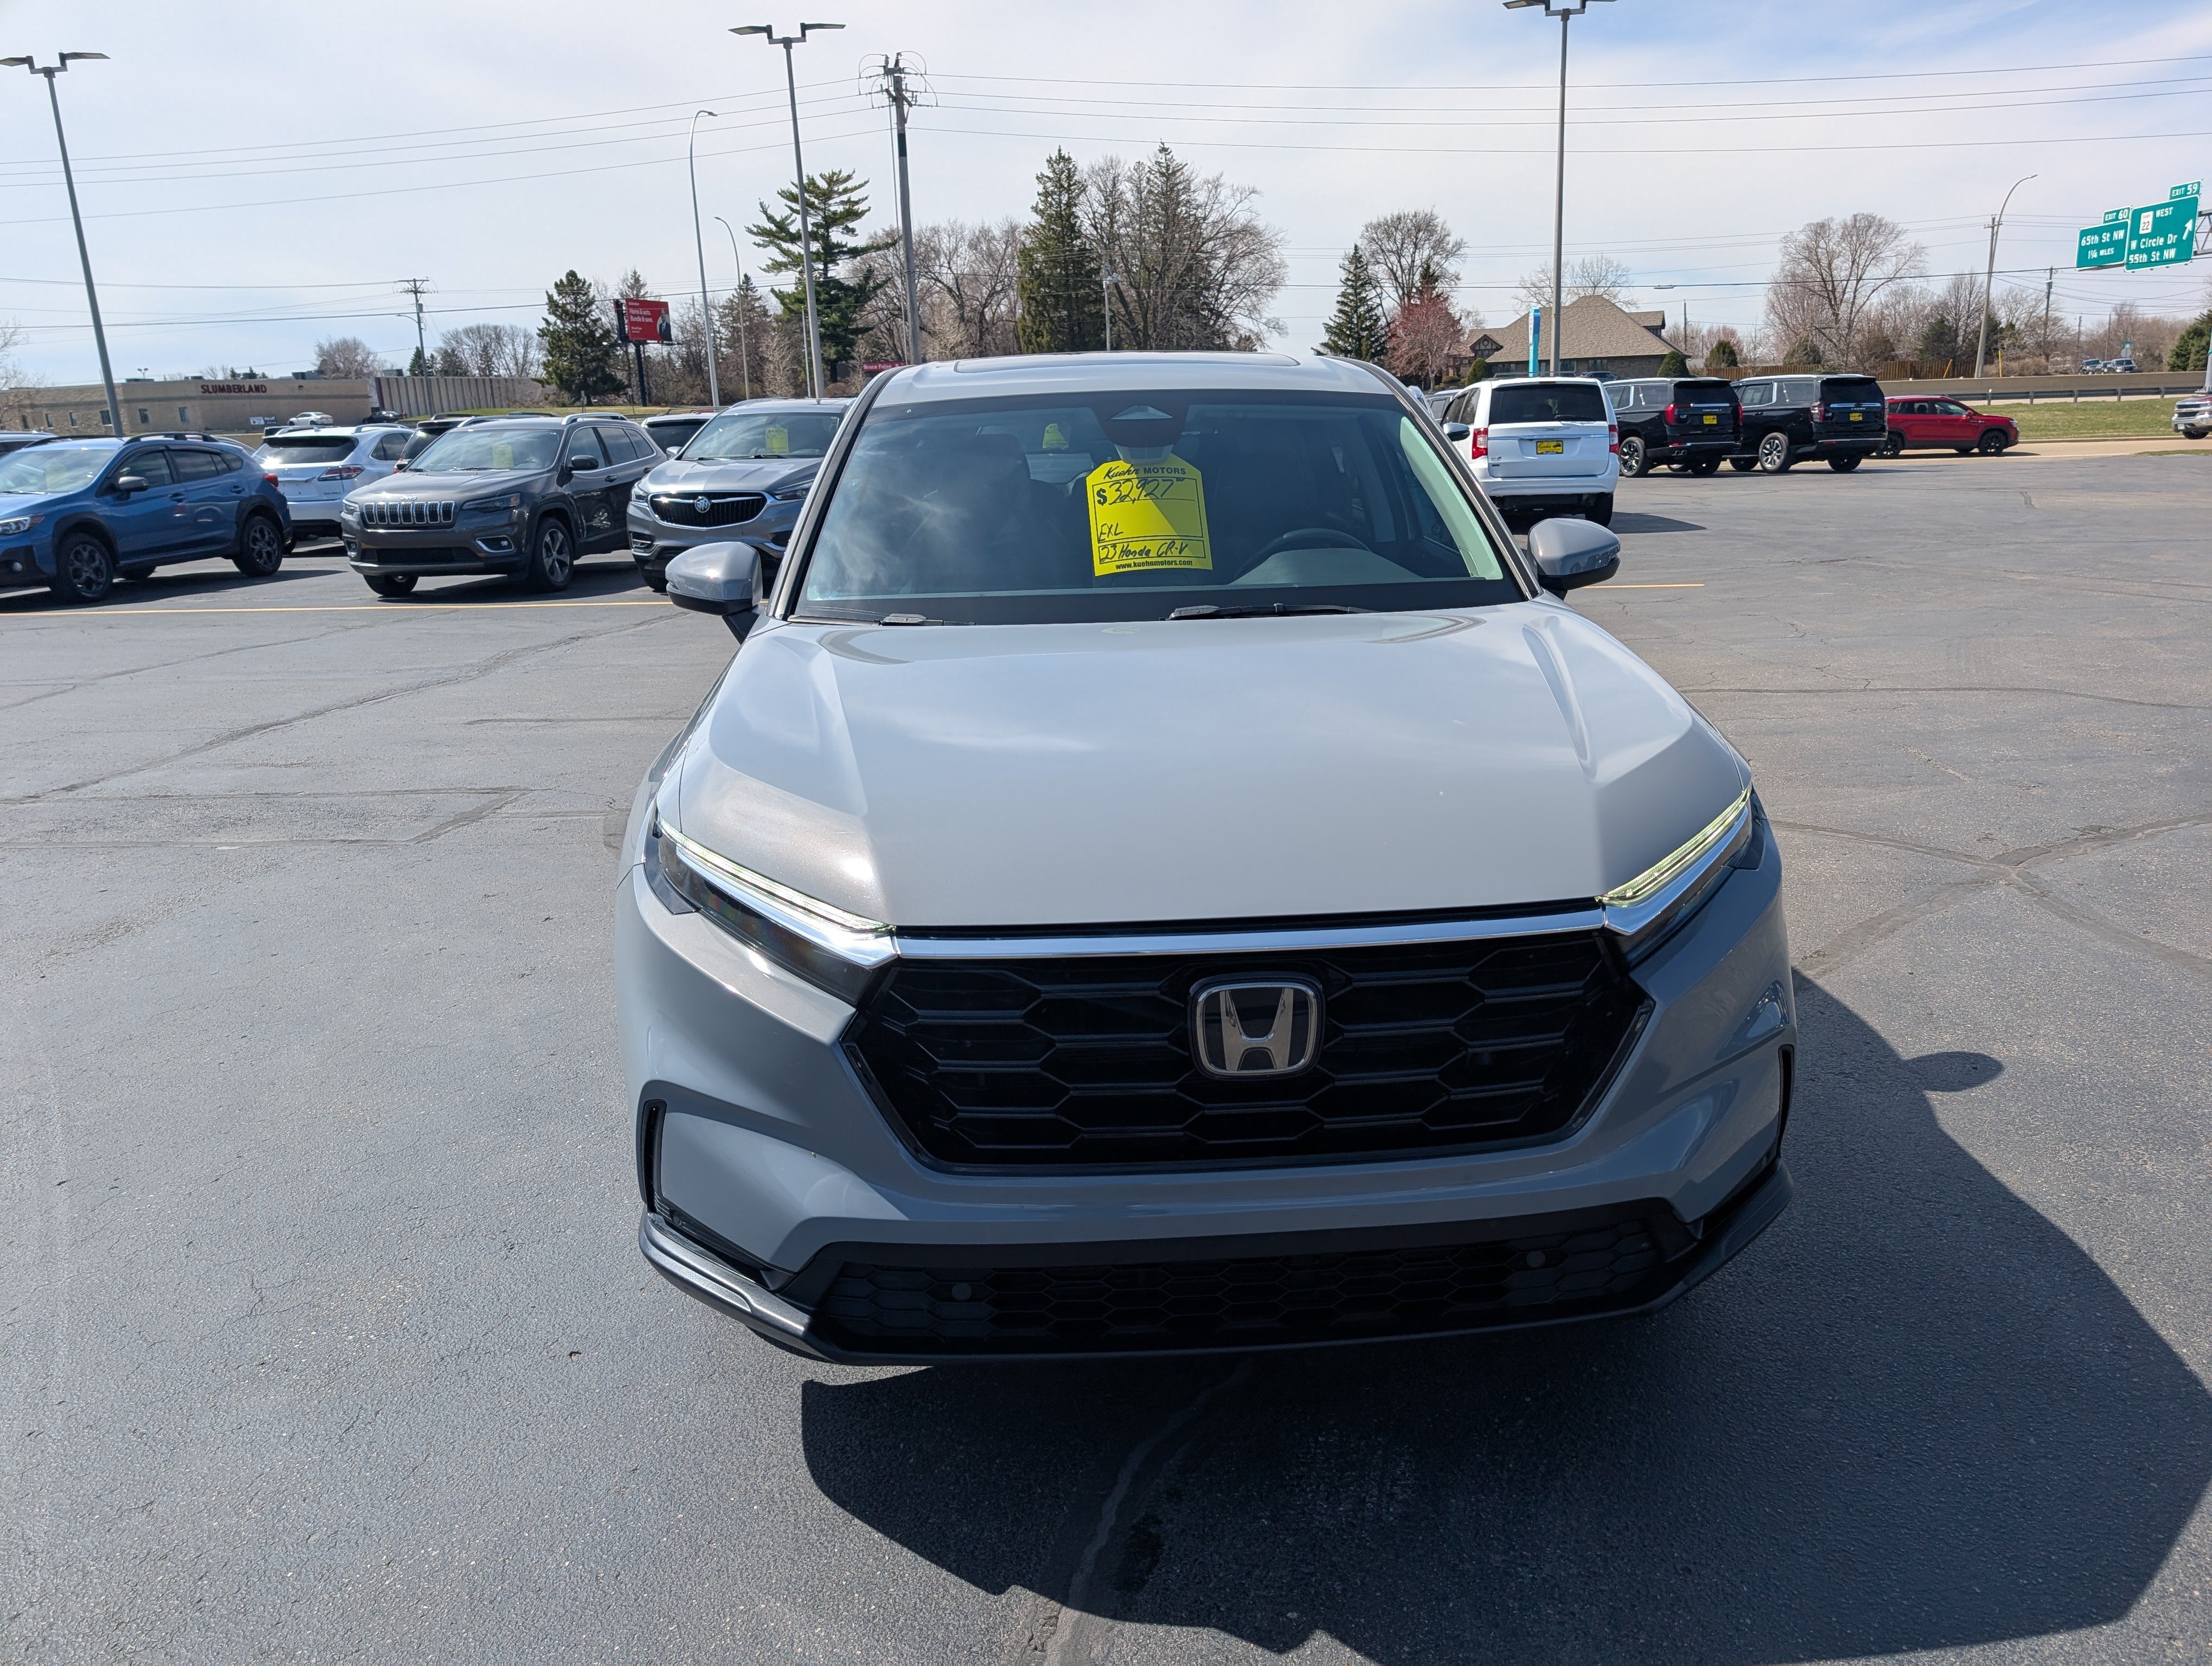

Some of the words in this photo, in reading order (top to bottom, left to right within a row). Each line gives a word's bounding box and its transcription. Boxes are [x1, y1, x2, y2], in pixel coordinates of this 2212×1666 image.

[2171, 187, 2185, 197] EXIT
[2187, 183, 2197, 195] 59
[2105, 213, 2117, 221] EXIT
[2118, 209, 2128, 219] 60
[2156, 207, 2173, 217] WEST
[2142, 221, 2150, 230] 22
[2081, 235, 2099, 246] 65th
[2101, 232, 2111, 242] St
[2113, 229, 2125, 241] NW
[2140, 236, 2164, 249] Circle
[2167, 234, 2178, 244] Dr
[2099, 247, 2114, 256] MILES
[2129, 253, 2147, 264] 55th
[2151, 251, 2160, 261] St
[2163, 248, 2176, 260] NW
[201, 384, 267, 394] SLUMBERLAND
[1103, 464, 1140, 479] Kuehn
[1101, 544, 1117, 562] 23
[1118, 543, 1152, 559] Honda
[1156, 540, 1188, 557] CR-V
[1115, 560, 1193, 569] www.kuehnmotors.com
